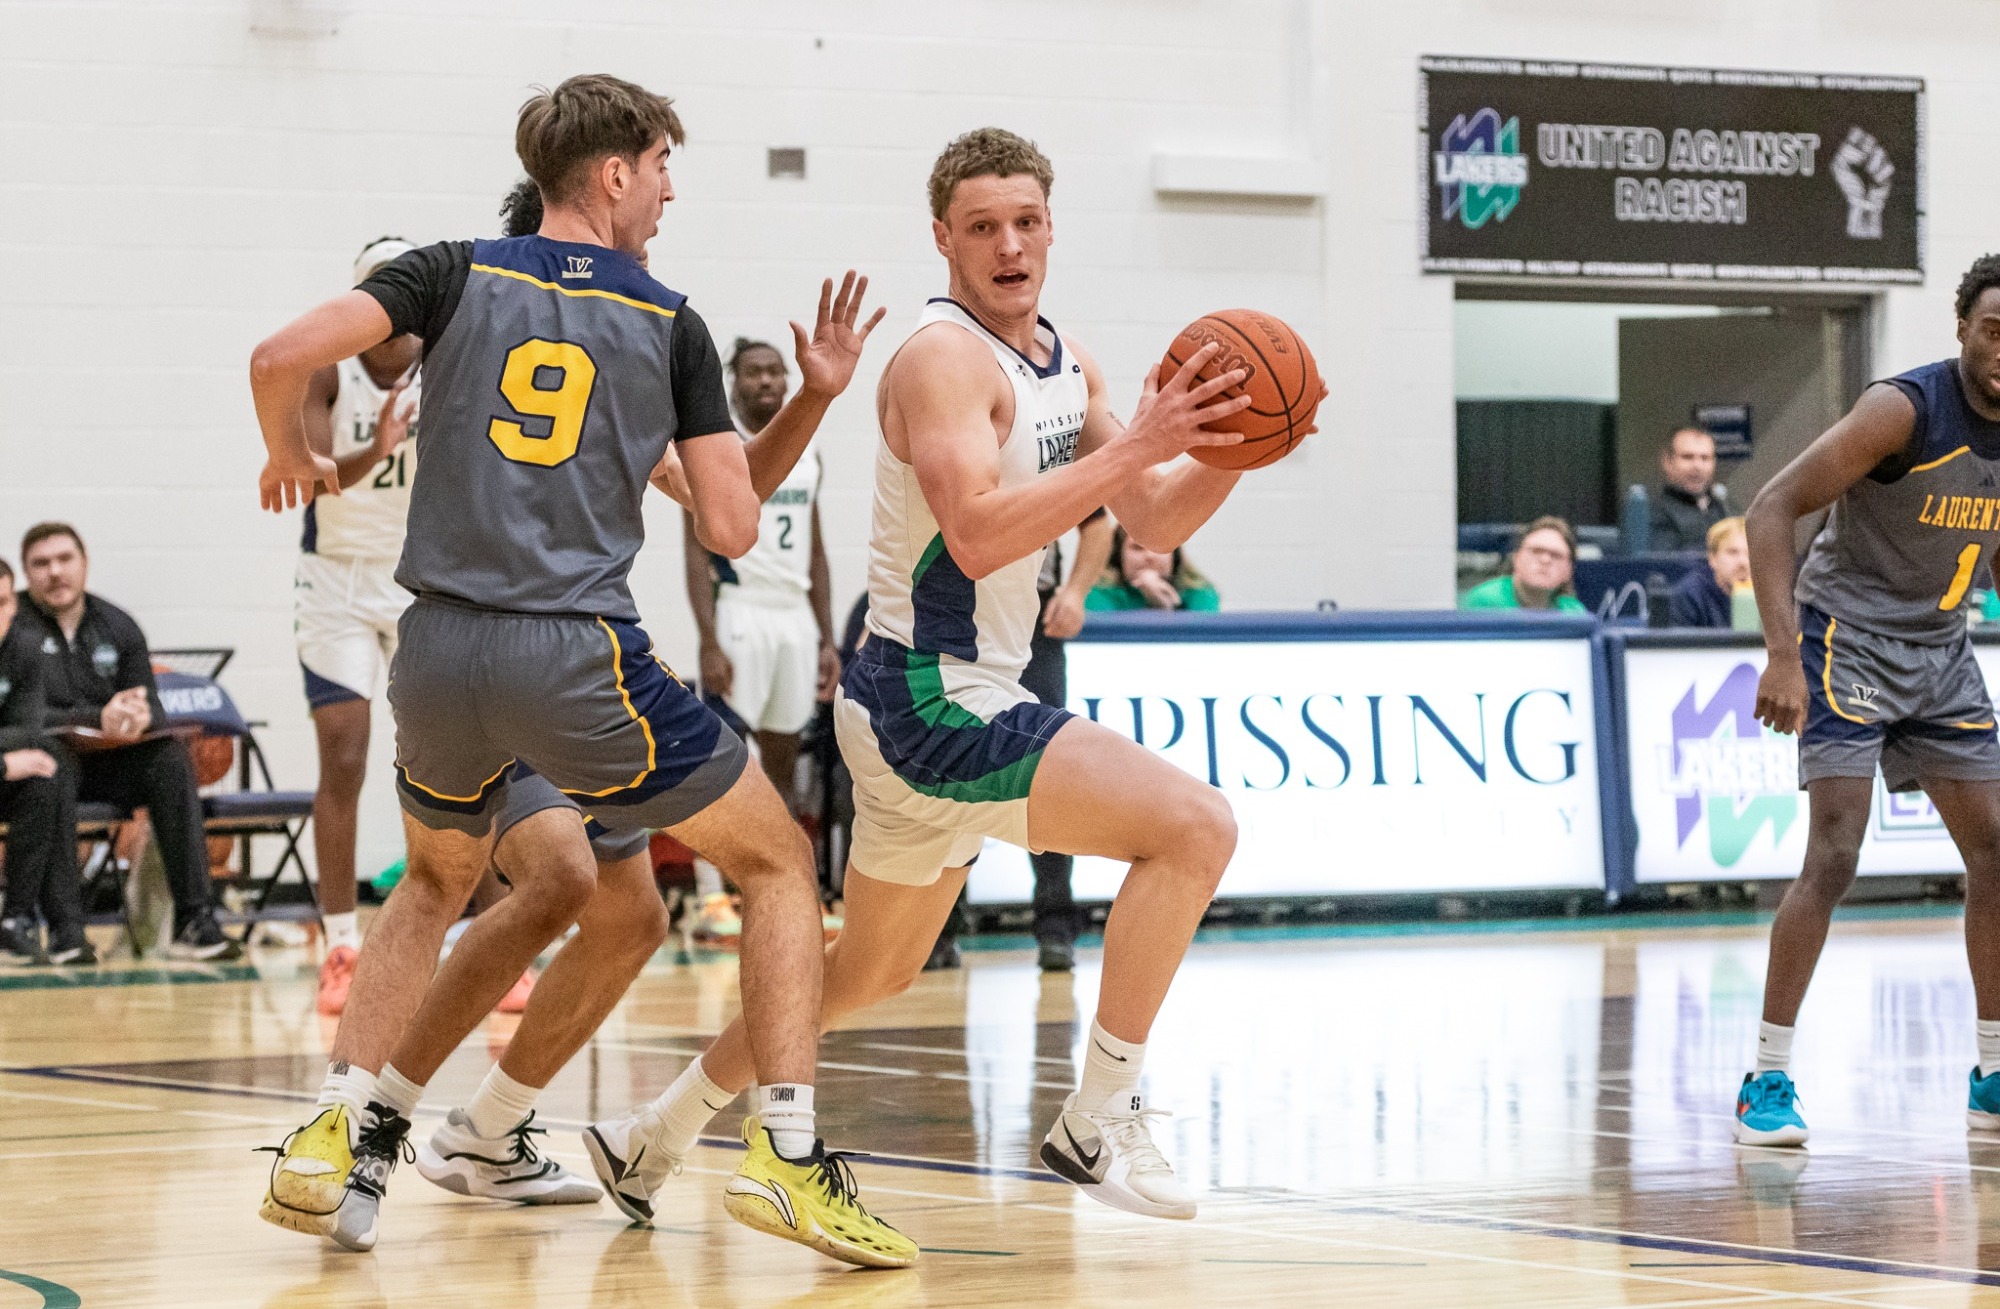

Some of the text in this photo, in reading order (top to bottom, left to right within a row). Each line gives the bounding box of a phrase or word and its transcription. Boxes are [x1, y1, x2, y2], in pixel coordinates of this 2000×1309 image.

[1537, 122, 1821, 177] UNITED AGAINST
[1614, 176, 1747, 224] RACISM
[486, 335, 600, 470] 9
[372, 449, 405, 489] 21
[777, 515, 793, 549] 2
[1937, 542, 1981, 611] 1
[1080, 689, 1582, 790] PISSING
